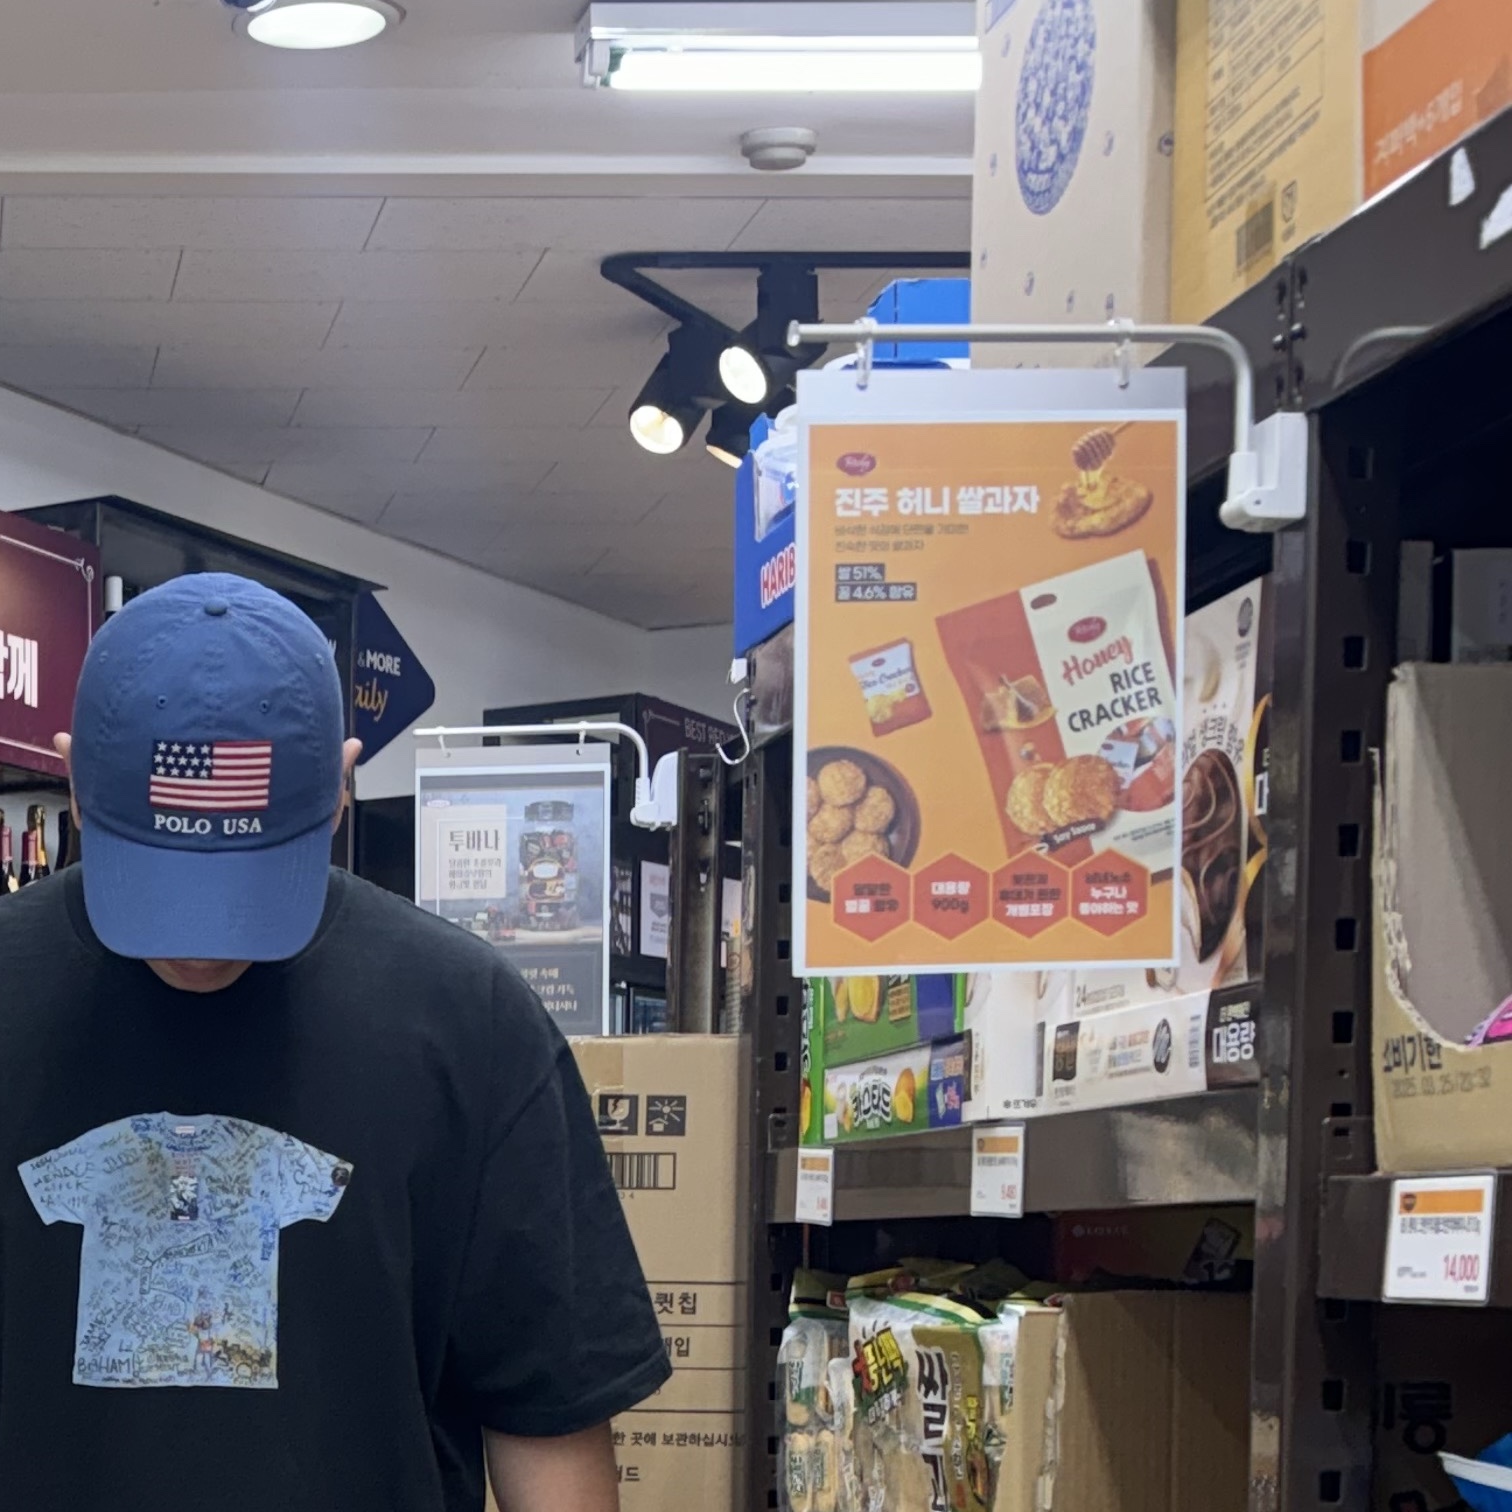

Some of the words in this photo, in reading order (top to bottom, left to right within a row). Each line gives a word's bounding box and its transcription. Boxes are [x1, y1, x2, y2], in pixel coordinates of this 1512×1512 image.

[835, 488, 889, 517] 진주
[897, 487, 950, 516] 허니
[957, 485, 1040, 515] 쌀과자
[853, 585, 887, 600] 4.6%
[366, 649, 401, 677] MORE
[1061, 634, 1134, 687] Honey
[1110, 661, 1156, 695] RICE
[1068, 686, 1163, 734] CRACKER
[153, 813, 212, 835] POLO
[223, 817, 262, 835] USA
[449, 829, 500, 852] 투바나
[931, 881, 970, 896] 대용량
[1091, 887, 1127, 900] 누구나
[932, 899, 970, 913] 900g
[1444, 1254, 1479, 1282] 14,000
[631, 1432, 656, 1447] 곳에
